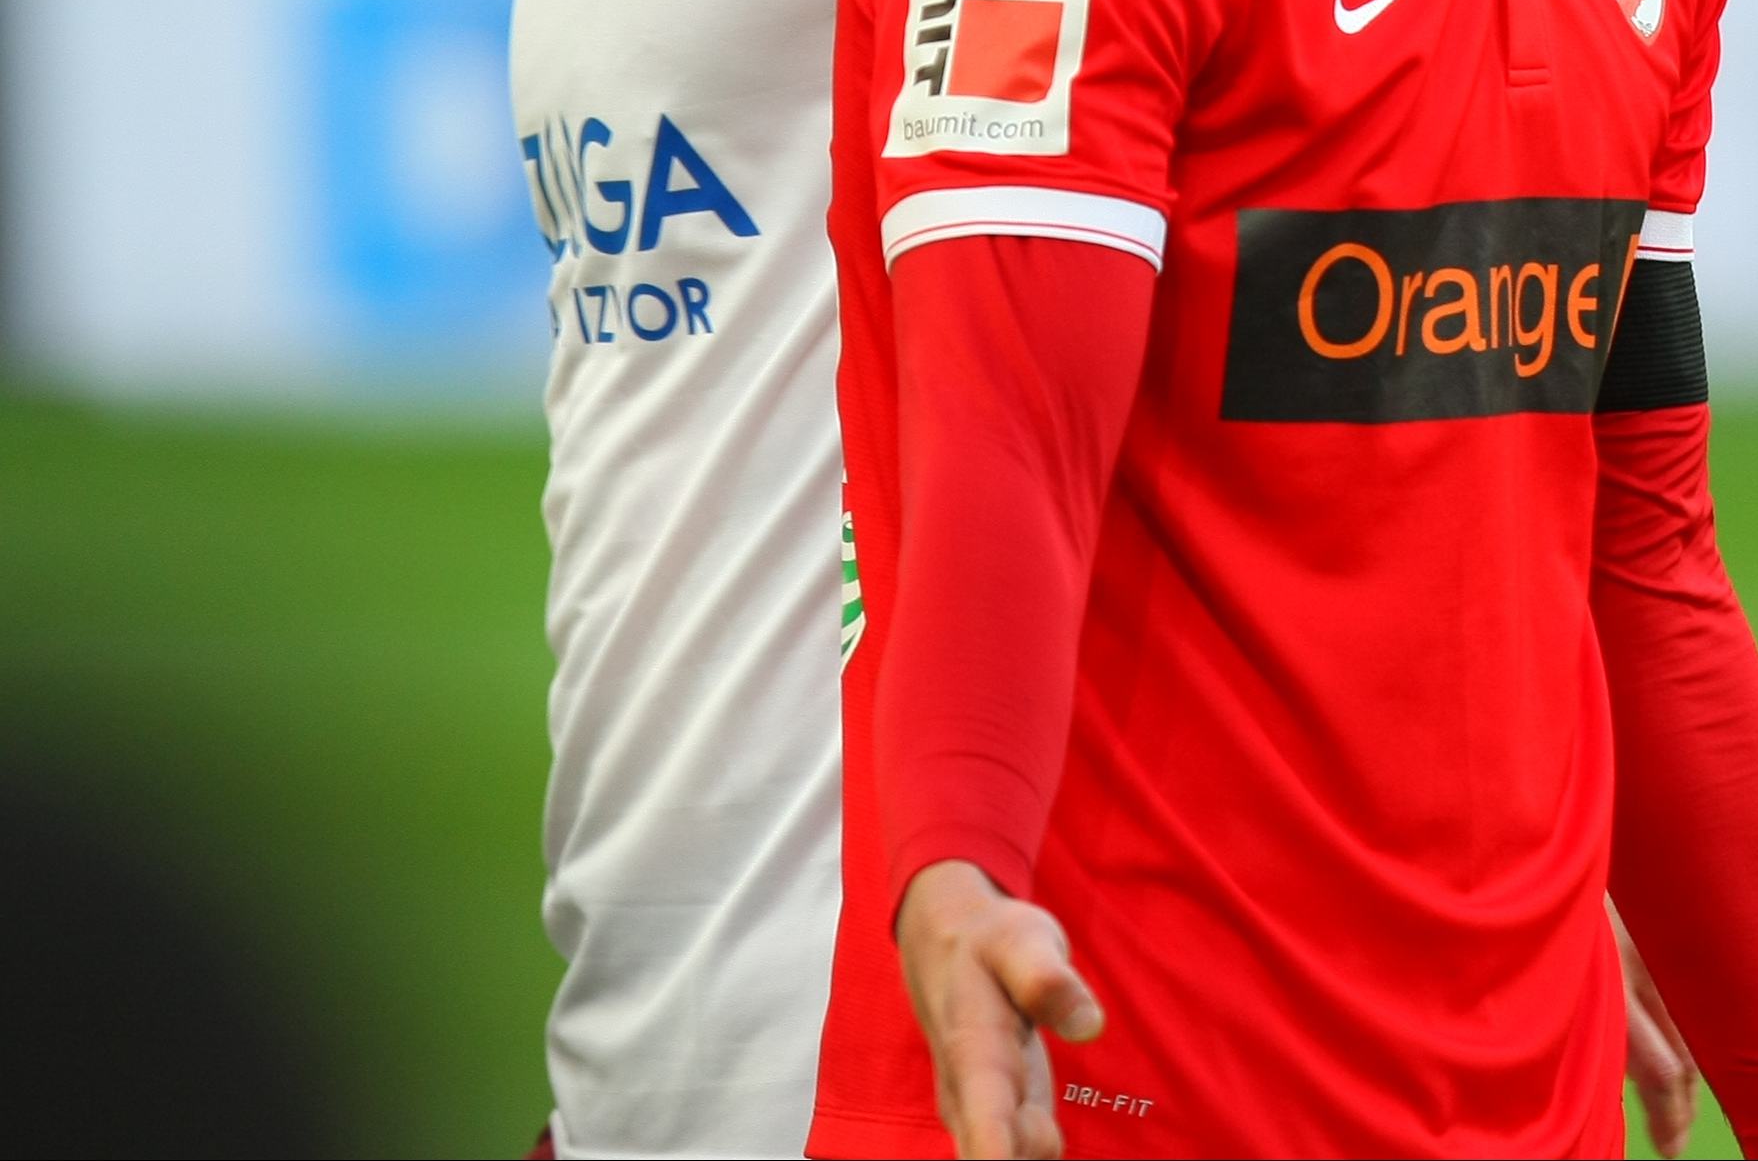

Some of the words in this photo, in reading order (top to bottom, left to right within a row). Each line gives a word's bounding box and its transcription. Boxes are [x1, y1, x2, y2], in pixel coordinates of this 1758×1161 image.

[902, 111, 1044, 141] baumit.com
[1297, 241, 1600, 378] Orange
[1063, 1083, 1154, 1118] DRI-FIT
